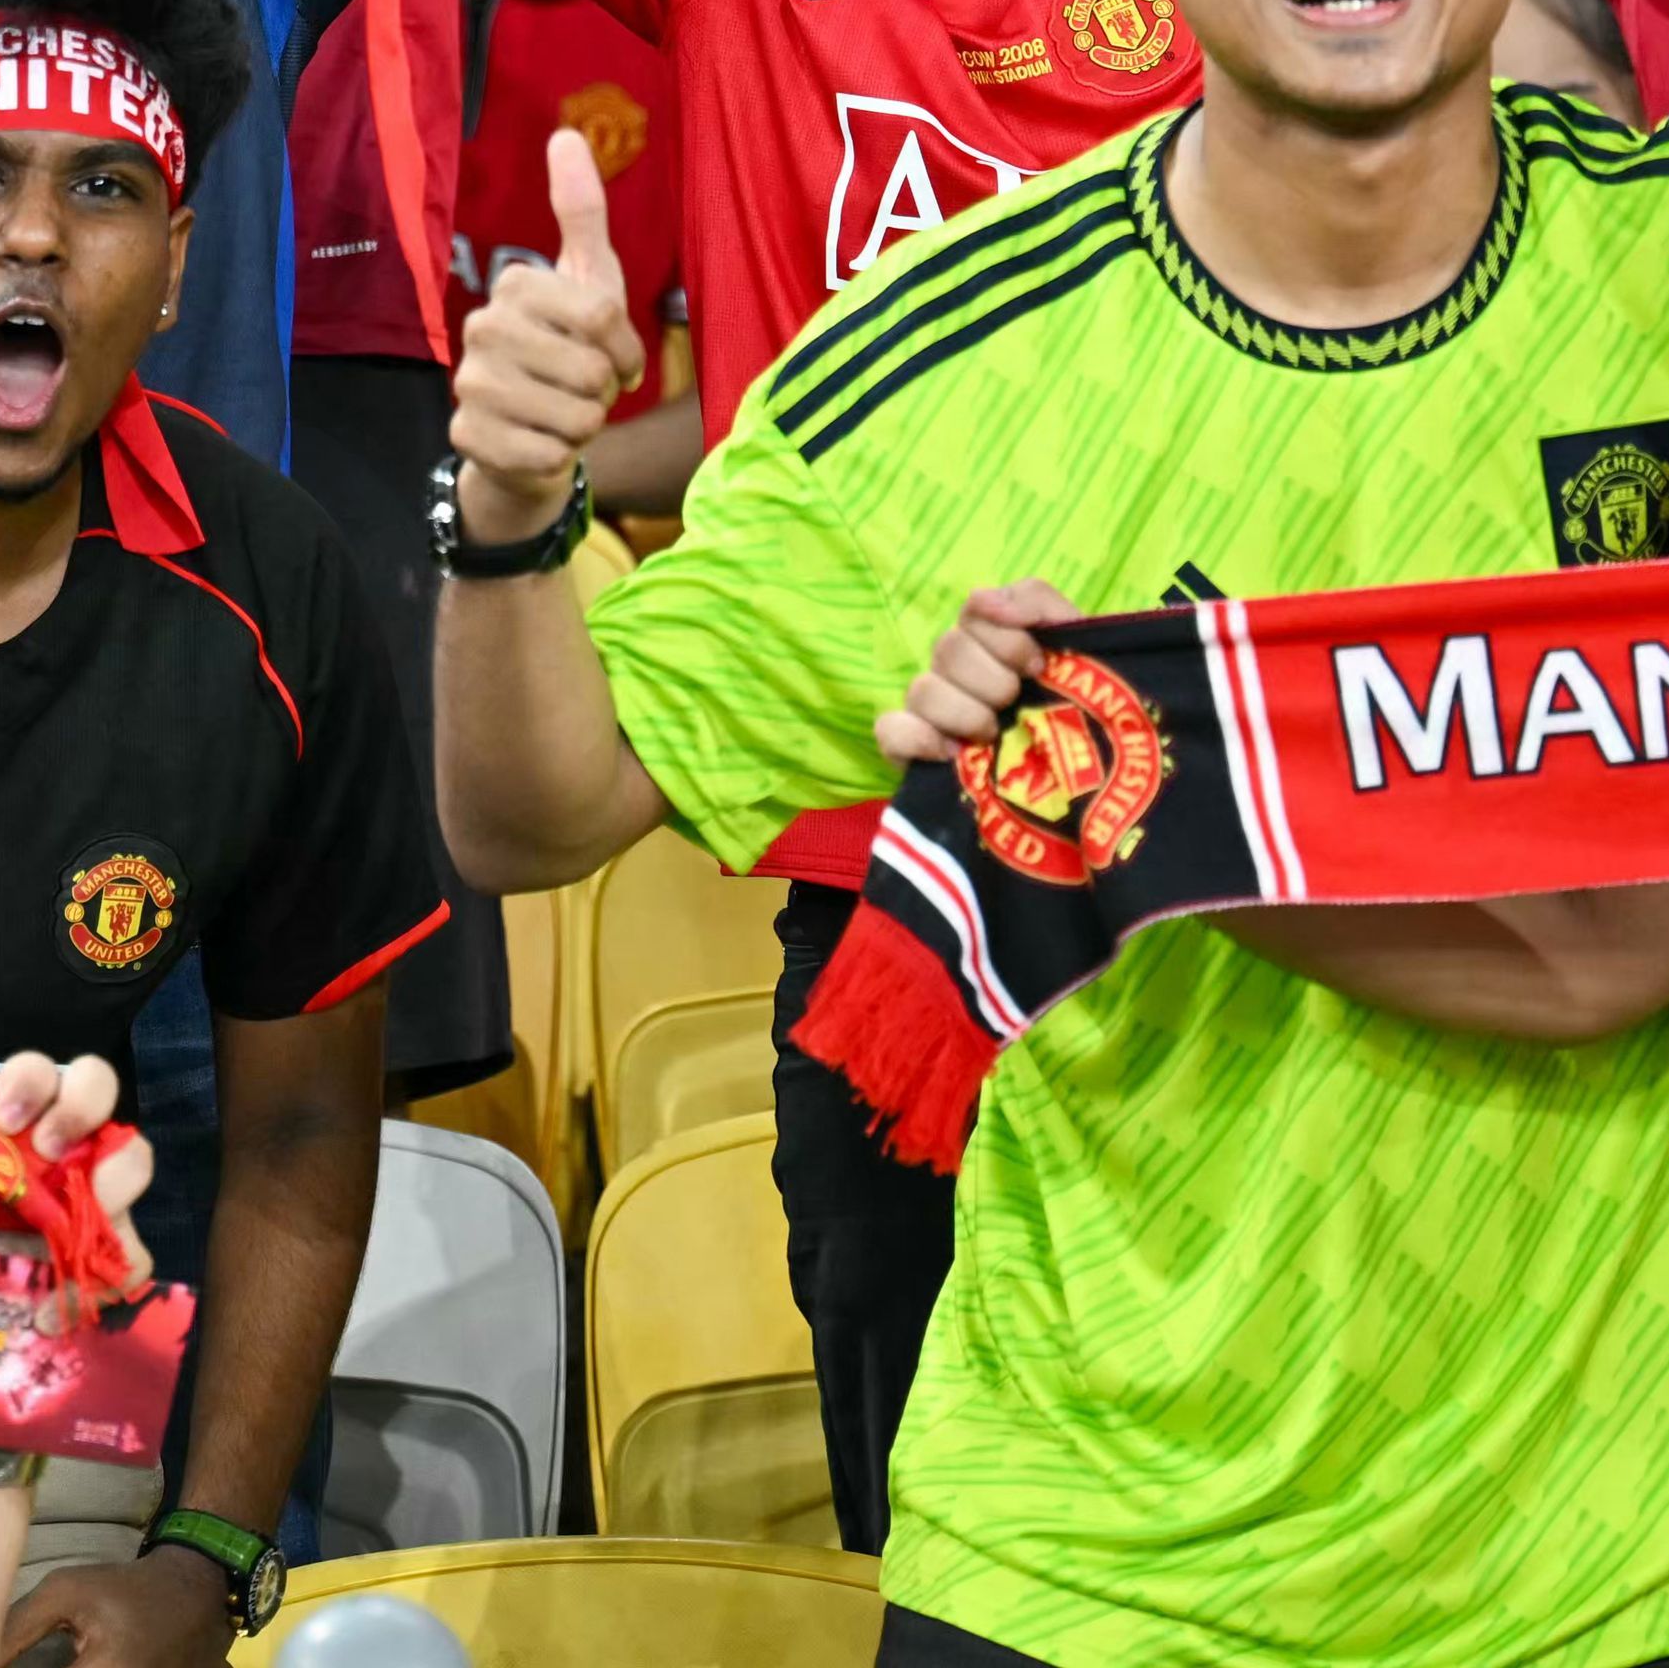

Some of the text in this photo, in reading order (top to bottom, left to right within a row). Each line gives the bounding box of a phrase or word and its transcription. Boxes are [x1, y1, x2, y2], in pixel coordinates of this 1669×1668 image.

[999, 37, 1046, 67] 2008
[1110, 36, 1165, 68] UNITED
[992, 58, 1054, 85] STADIUM
[1571, 454, 1667, 510] MANCHESTER
[1046, 653, 1154, 849] MANCHESTER
[964, 748, 1046, 866] UNTED
[80, 862, 169, 902] MANCHESTER
[83, 939, 145, 961] UNITED
